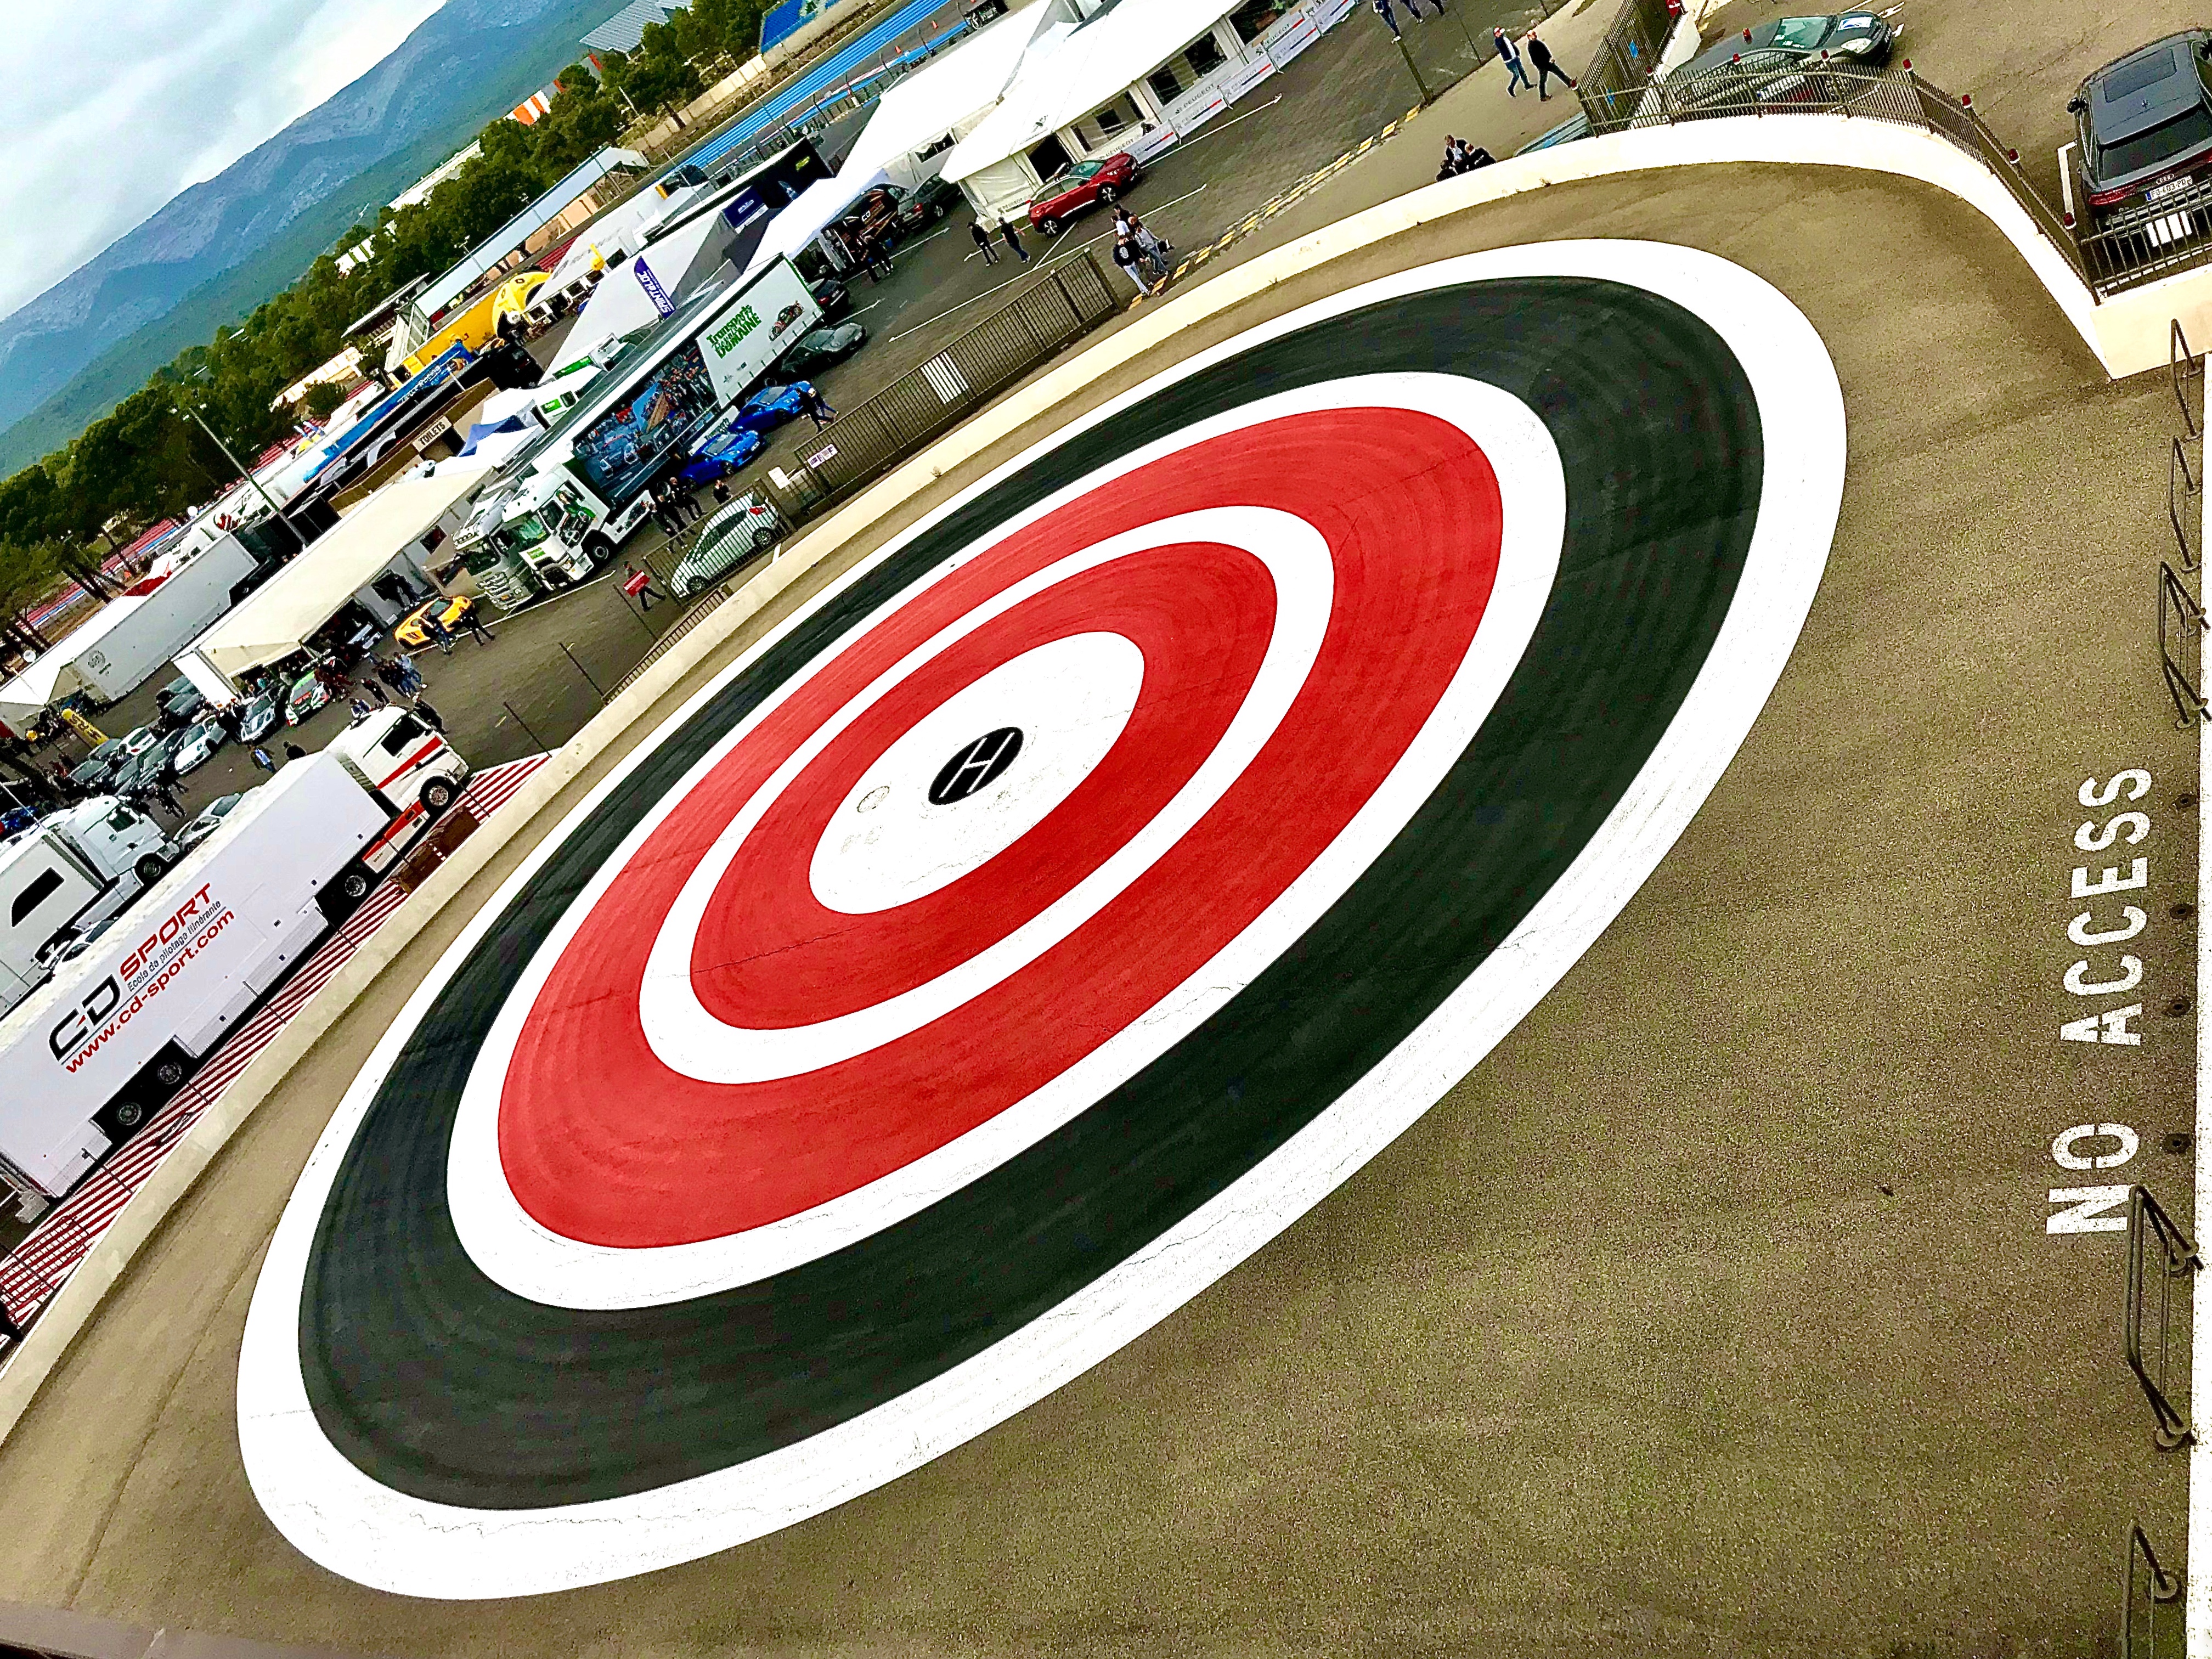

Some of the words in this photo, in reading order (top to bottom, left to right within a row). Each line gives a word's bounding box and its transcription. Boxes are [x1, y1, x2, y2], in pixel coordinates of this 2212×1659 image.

[1182, 83, 1216, 109] PEUGEOT
[418, 421, 445, 445] TOILETS
[939, 732, 1015, 798] H
[159, 932, 188, 964] pilotage
[2061, 769, 2152, 1046] ACCESS
[49, 974, 121, 1062] CD
[120, 883, 211, 982] SPORT
[66, 910, 235, 1073] www.cd-sport.com
[2046, 1122, 2140, 1234] NO
